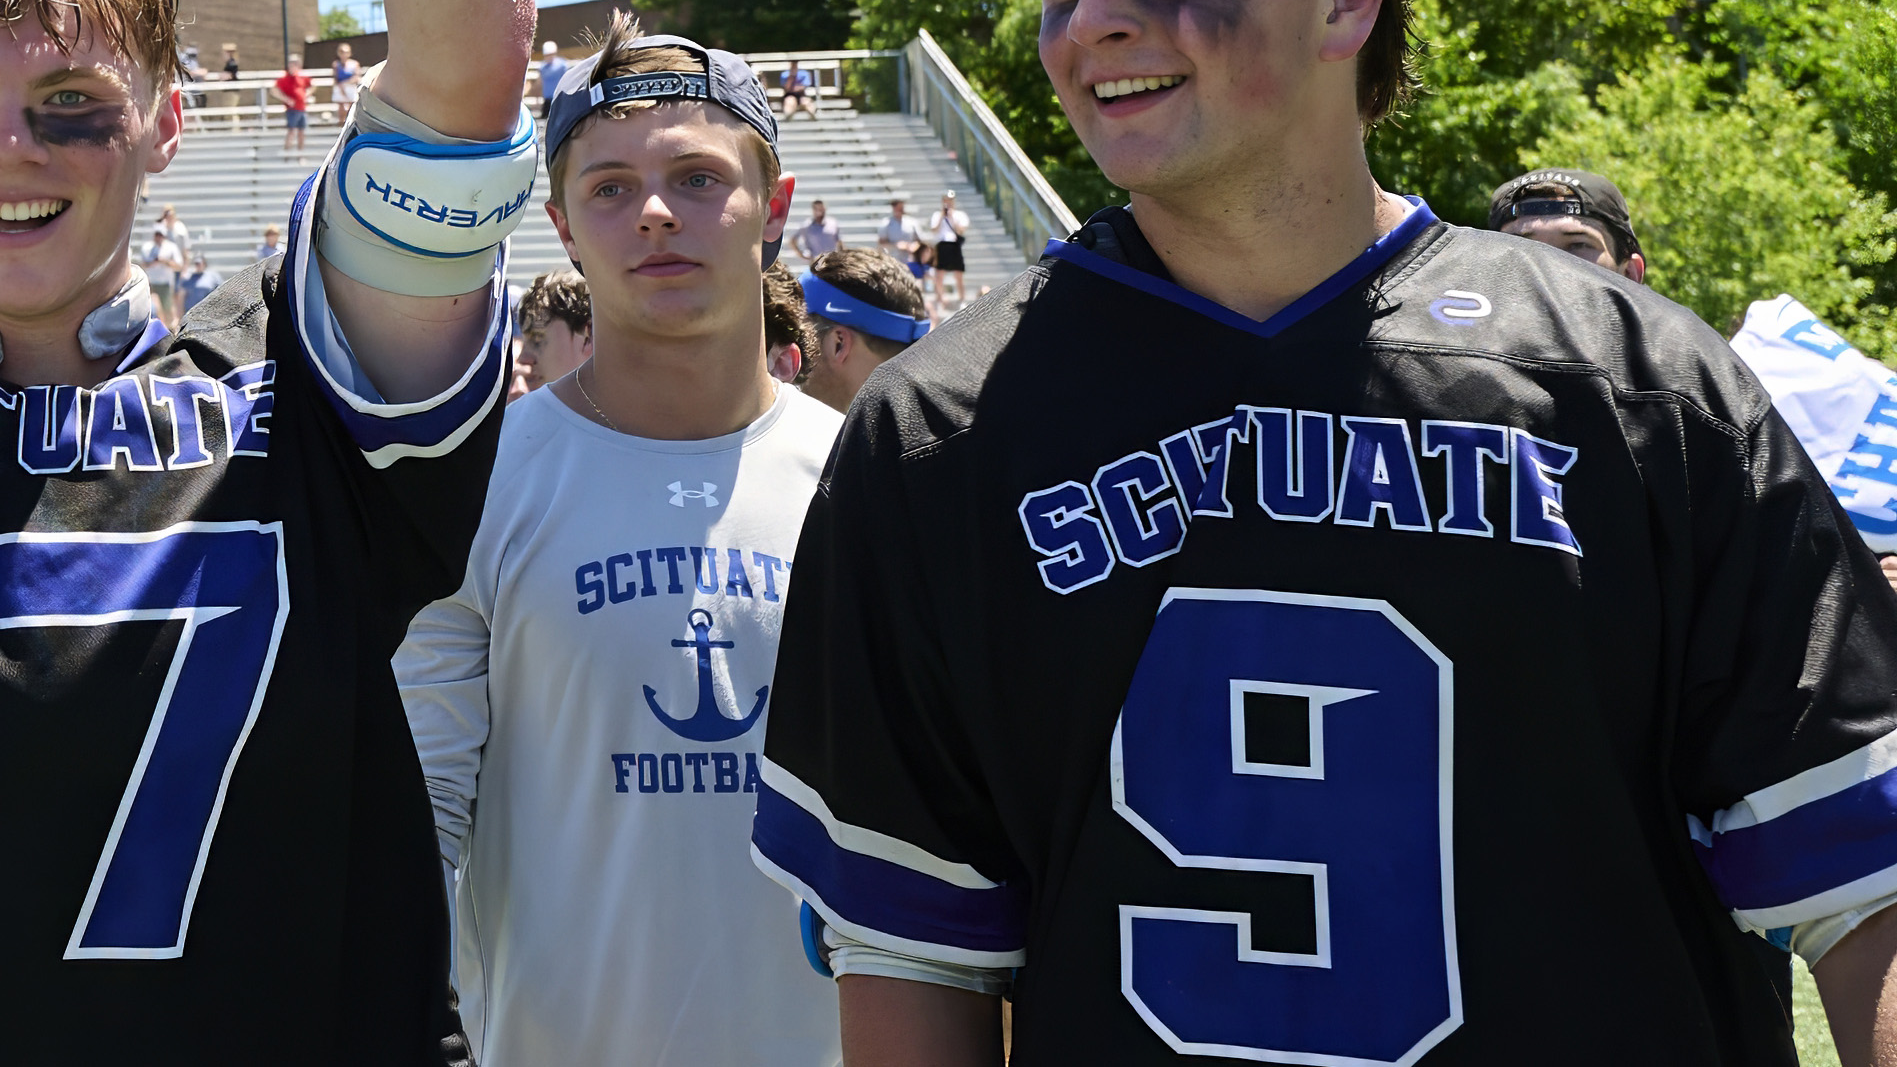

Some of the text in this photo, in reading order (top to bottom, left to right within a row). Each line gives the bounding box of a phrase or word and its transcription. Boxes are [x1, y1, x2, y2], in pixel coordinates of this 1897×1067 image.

[575, 546, 793, 615] SCITUAT
[1018, 404, 1583, 595] SCITUATE
[1110, 586, 1464, 1067] 9
